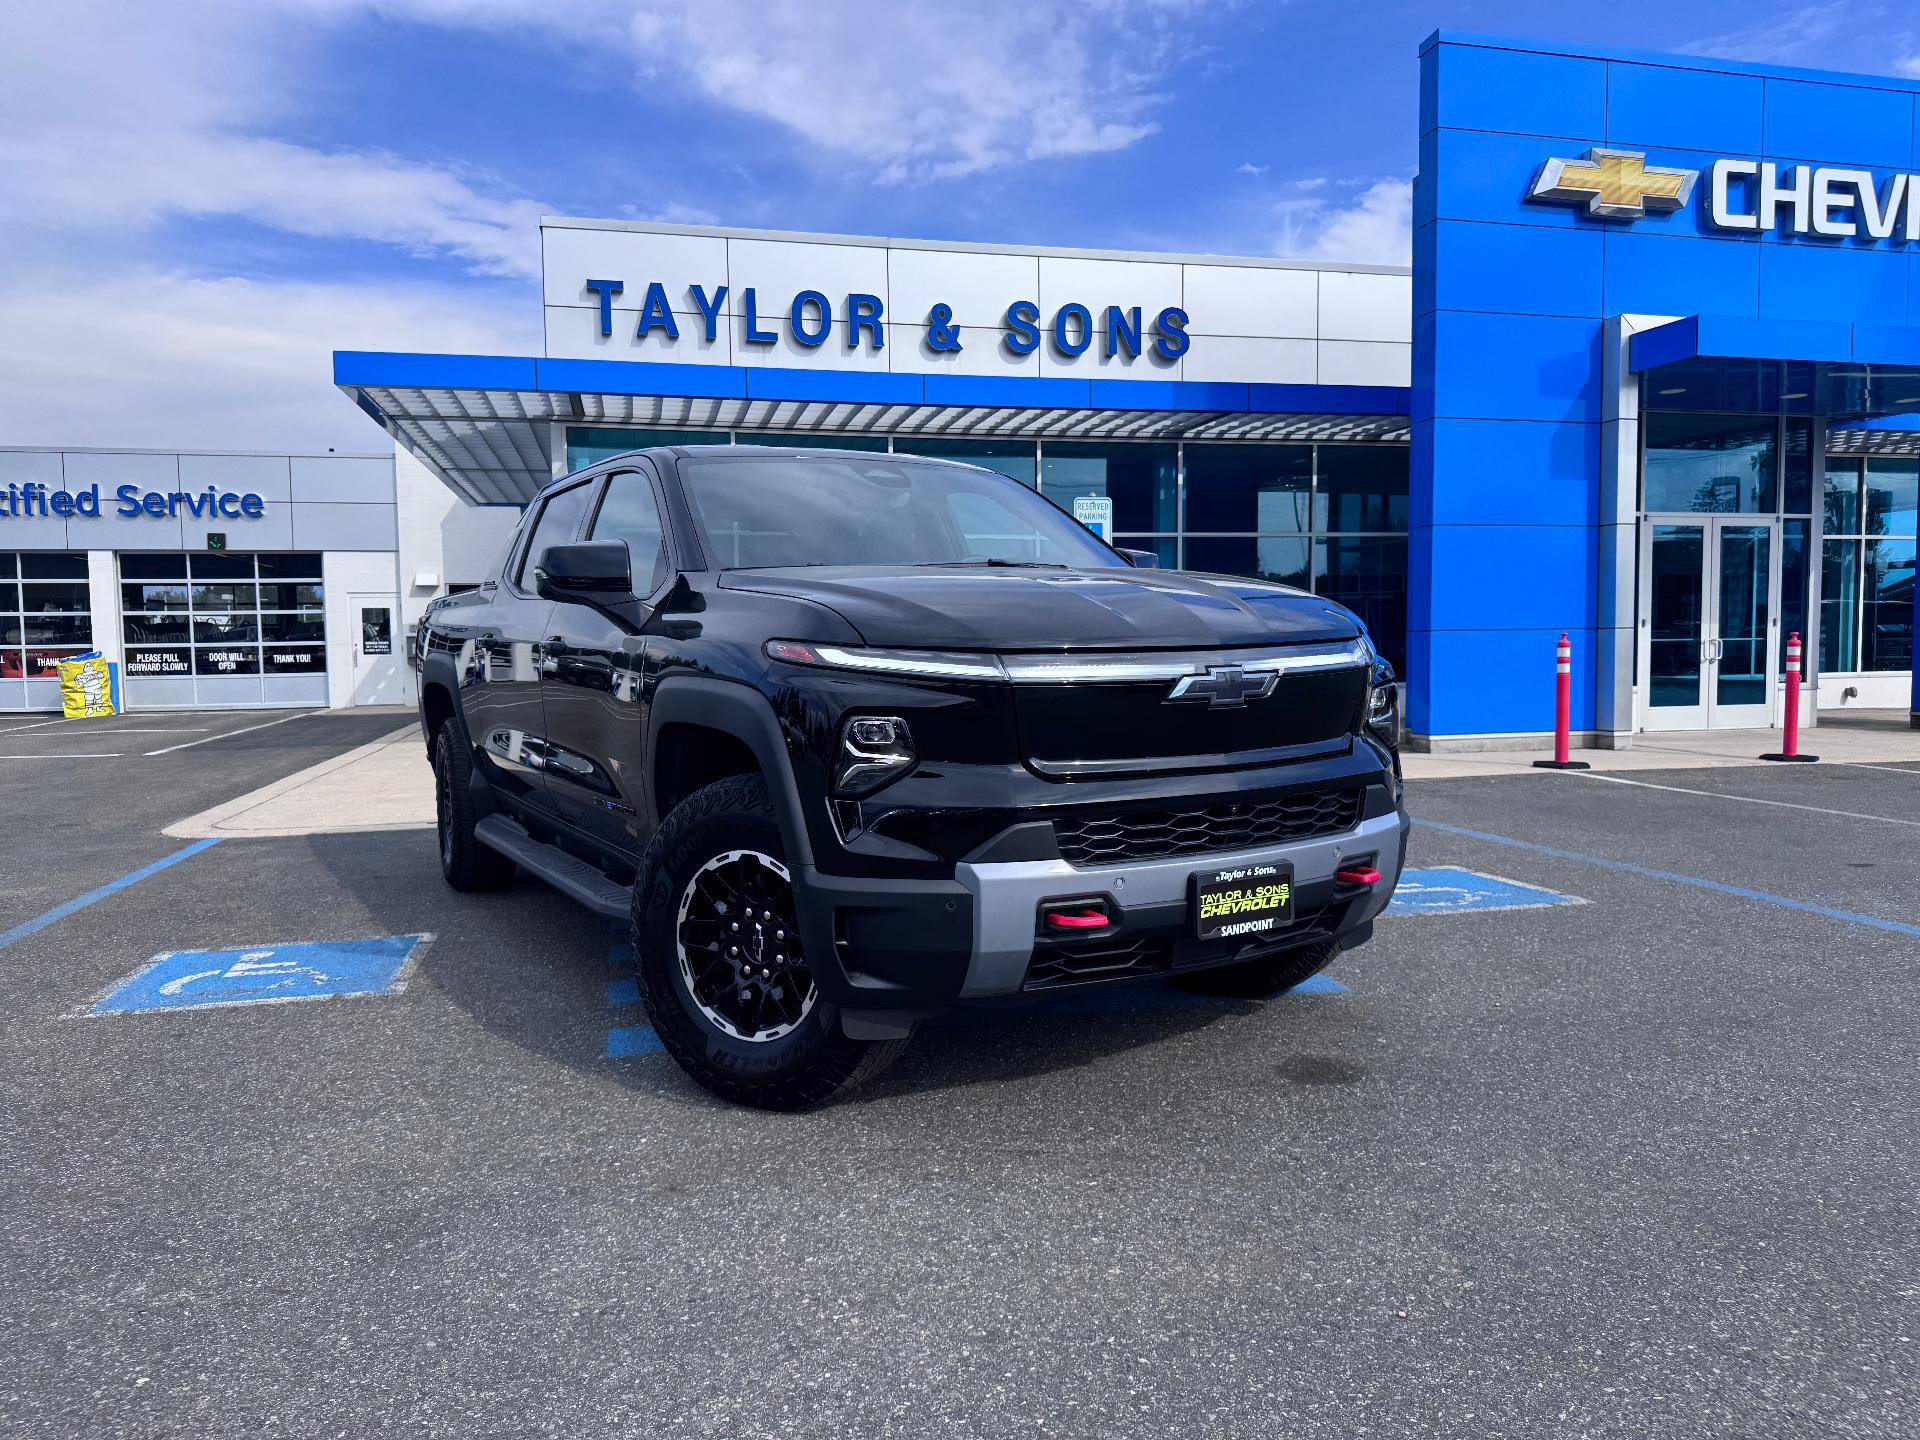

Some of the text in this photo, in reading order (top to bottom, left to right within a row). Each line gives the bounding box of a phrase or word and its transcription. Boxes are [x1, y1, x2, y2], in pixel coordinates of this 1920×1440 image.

[585, 278, 1191, 360] TAYLOR & SONS
[116, 484, 264, 518] Service
[1077, 502, 1109, 511] RESERVED
[1079, 512, 1107, 521] PARKING
[136, 653, 180, 663] PLEASE PULL
[209, 652, 245, 662] DOOR WILL
[273, 653, 312, 664] THANK YOU!
[128, 662, 188, 672] FORWARD SLOWLY
[218, 661, 237, 670] OPEN
[1219, 866, 1274, 882] Taylor & Sons
[1200, 884, 1289, 905] TAYLOR & SONS
[1200, 895, 1290, 919] CHEVROLET
[1220, 918, 1274, 937] SANDPOINT
